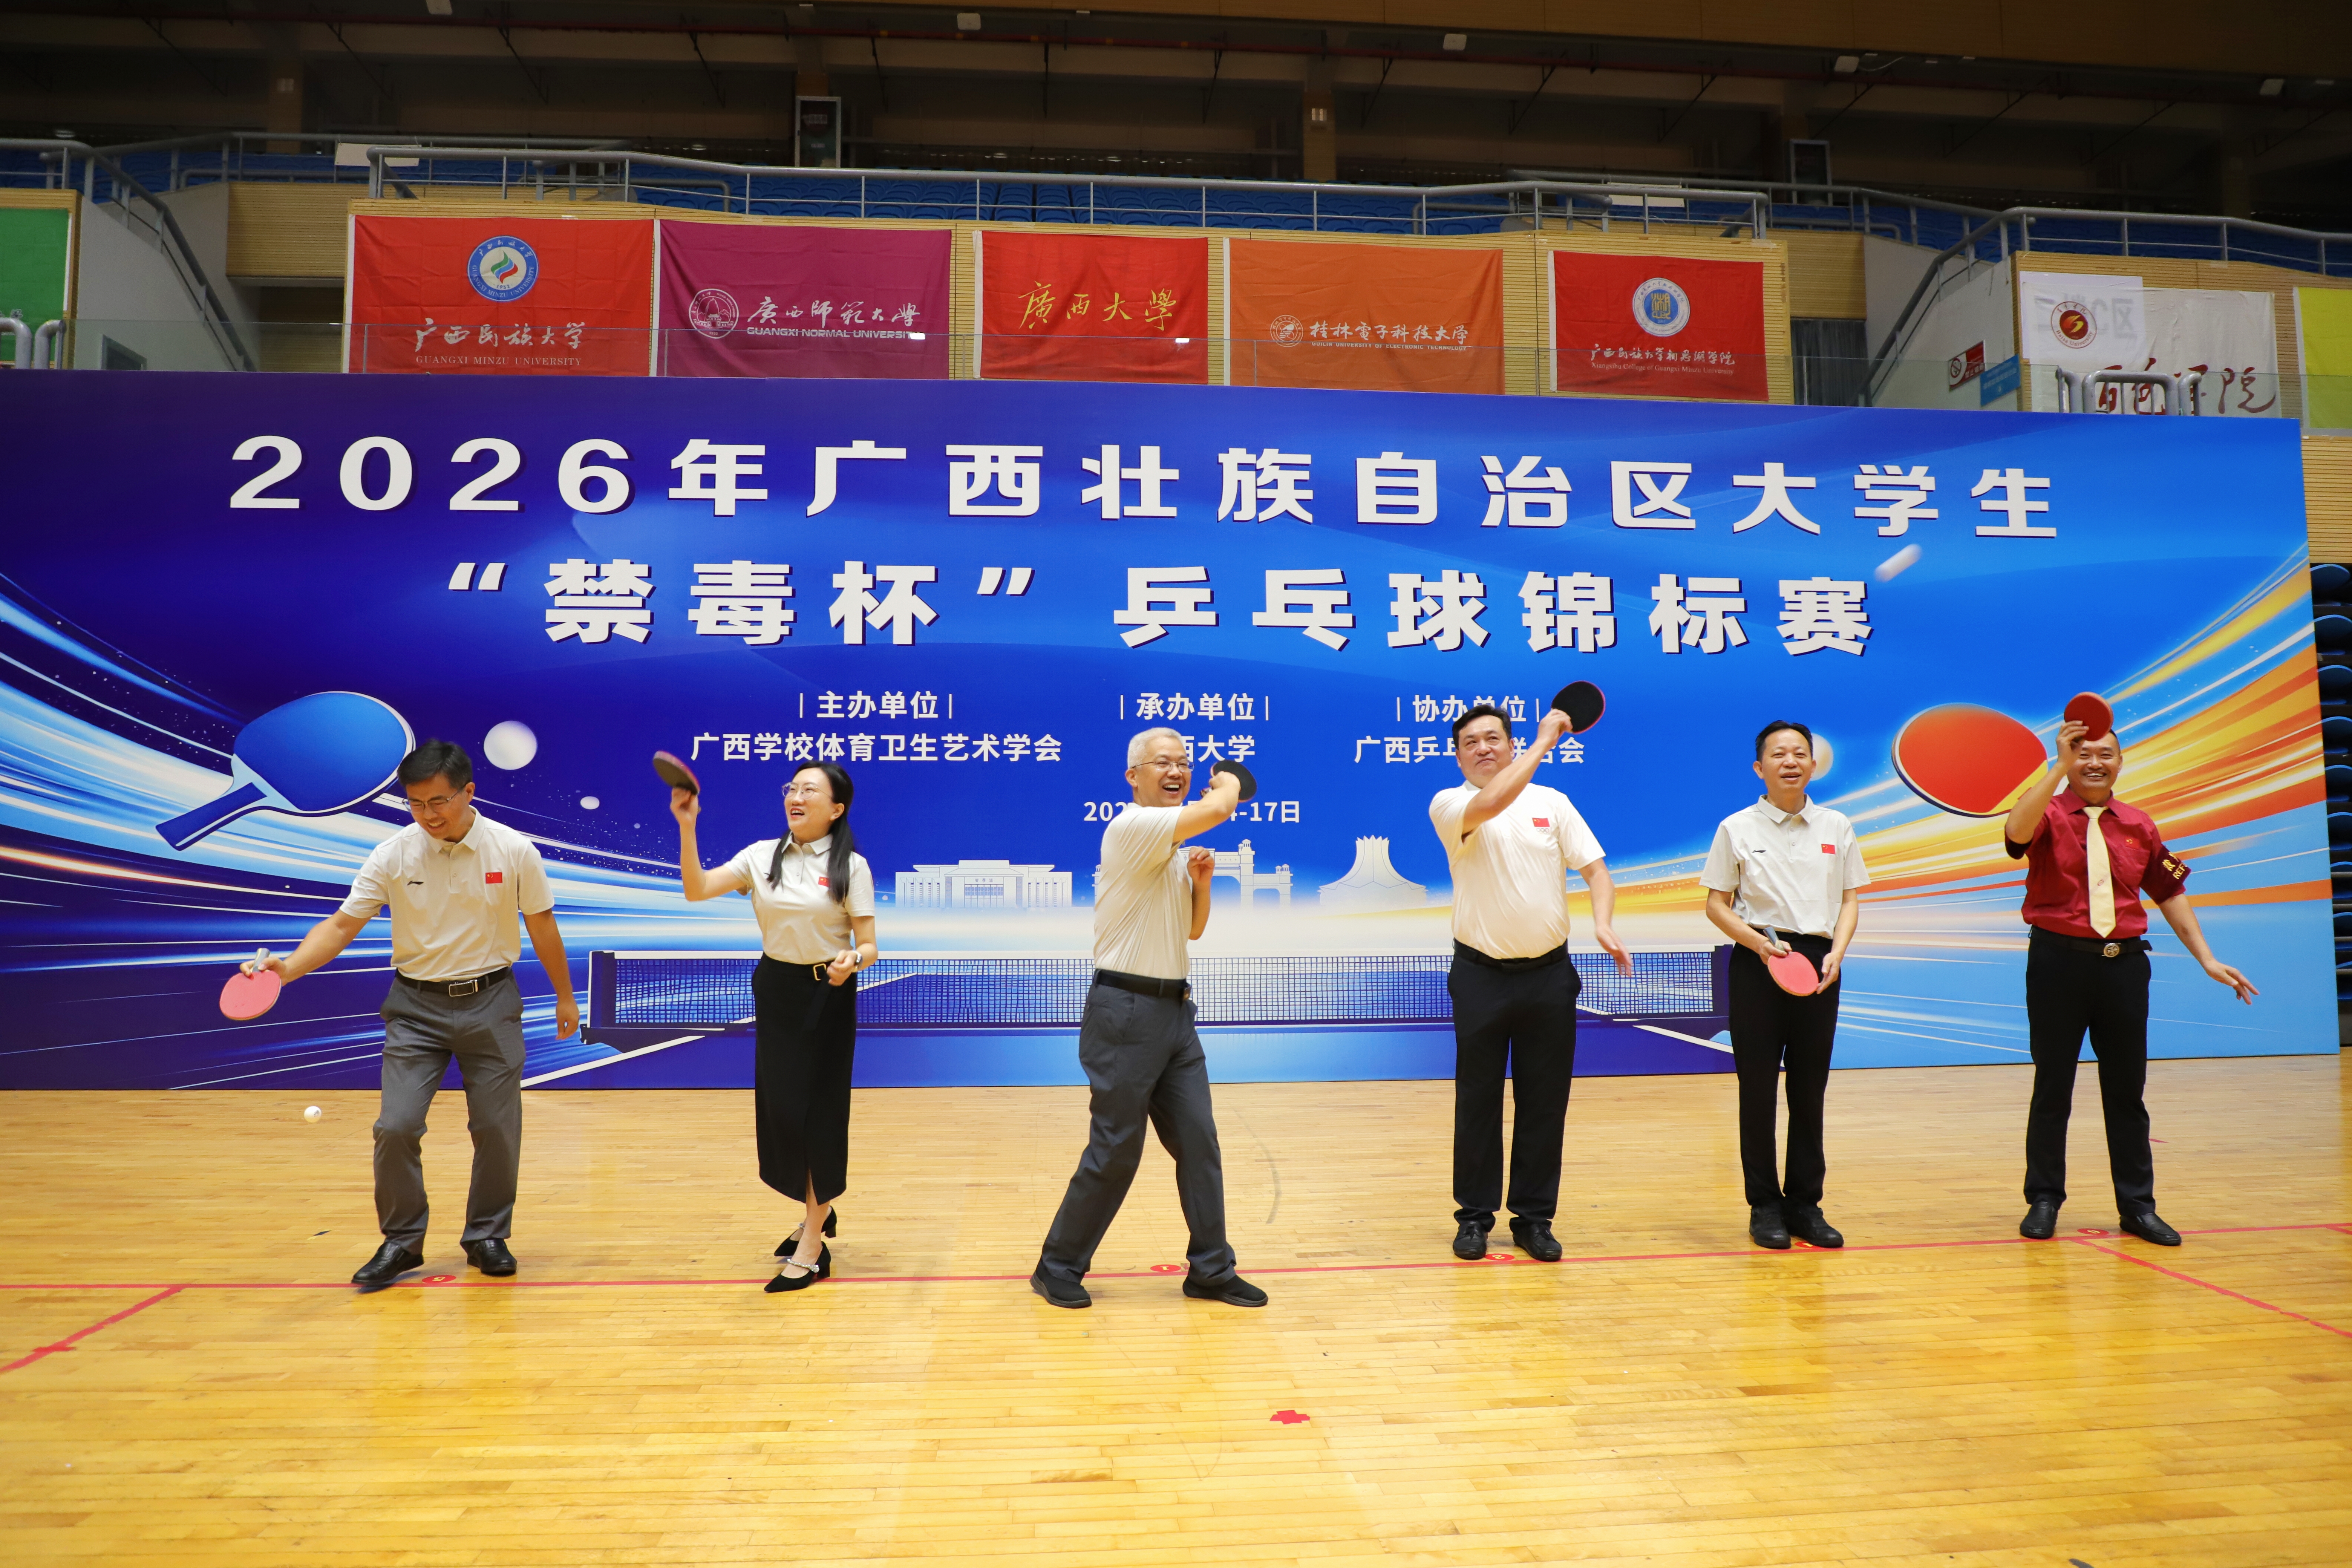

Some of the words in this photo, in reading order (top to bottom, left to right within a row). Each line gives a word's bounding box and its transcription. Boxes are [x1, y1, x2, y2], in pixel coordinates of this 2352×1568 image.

[1018, 280, 1176, 331] 廣西大學
[415, 317, 585, 352] 广西民族大学
[747, 327, 798, 336] GUANGXI
[802, 329, 850, 338] NORMAL
[853, 330, 923, 339] UNIVERSIT
[416, 356, 468, 364] GUANGXI
[1655, 365, 1680, 373] Guangxi
[1703, 367, 1734, 376] University
[230, 435, 2057, 537] 2026年广西壮族自治区大学生
[816, 691, 939, 719] 主办单位
[1136, 692, 1255, 721] 承办单位
[691, 732, 1062, 762] 广西学校体育卫生艺术学会
